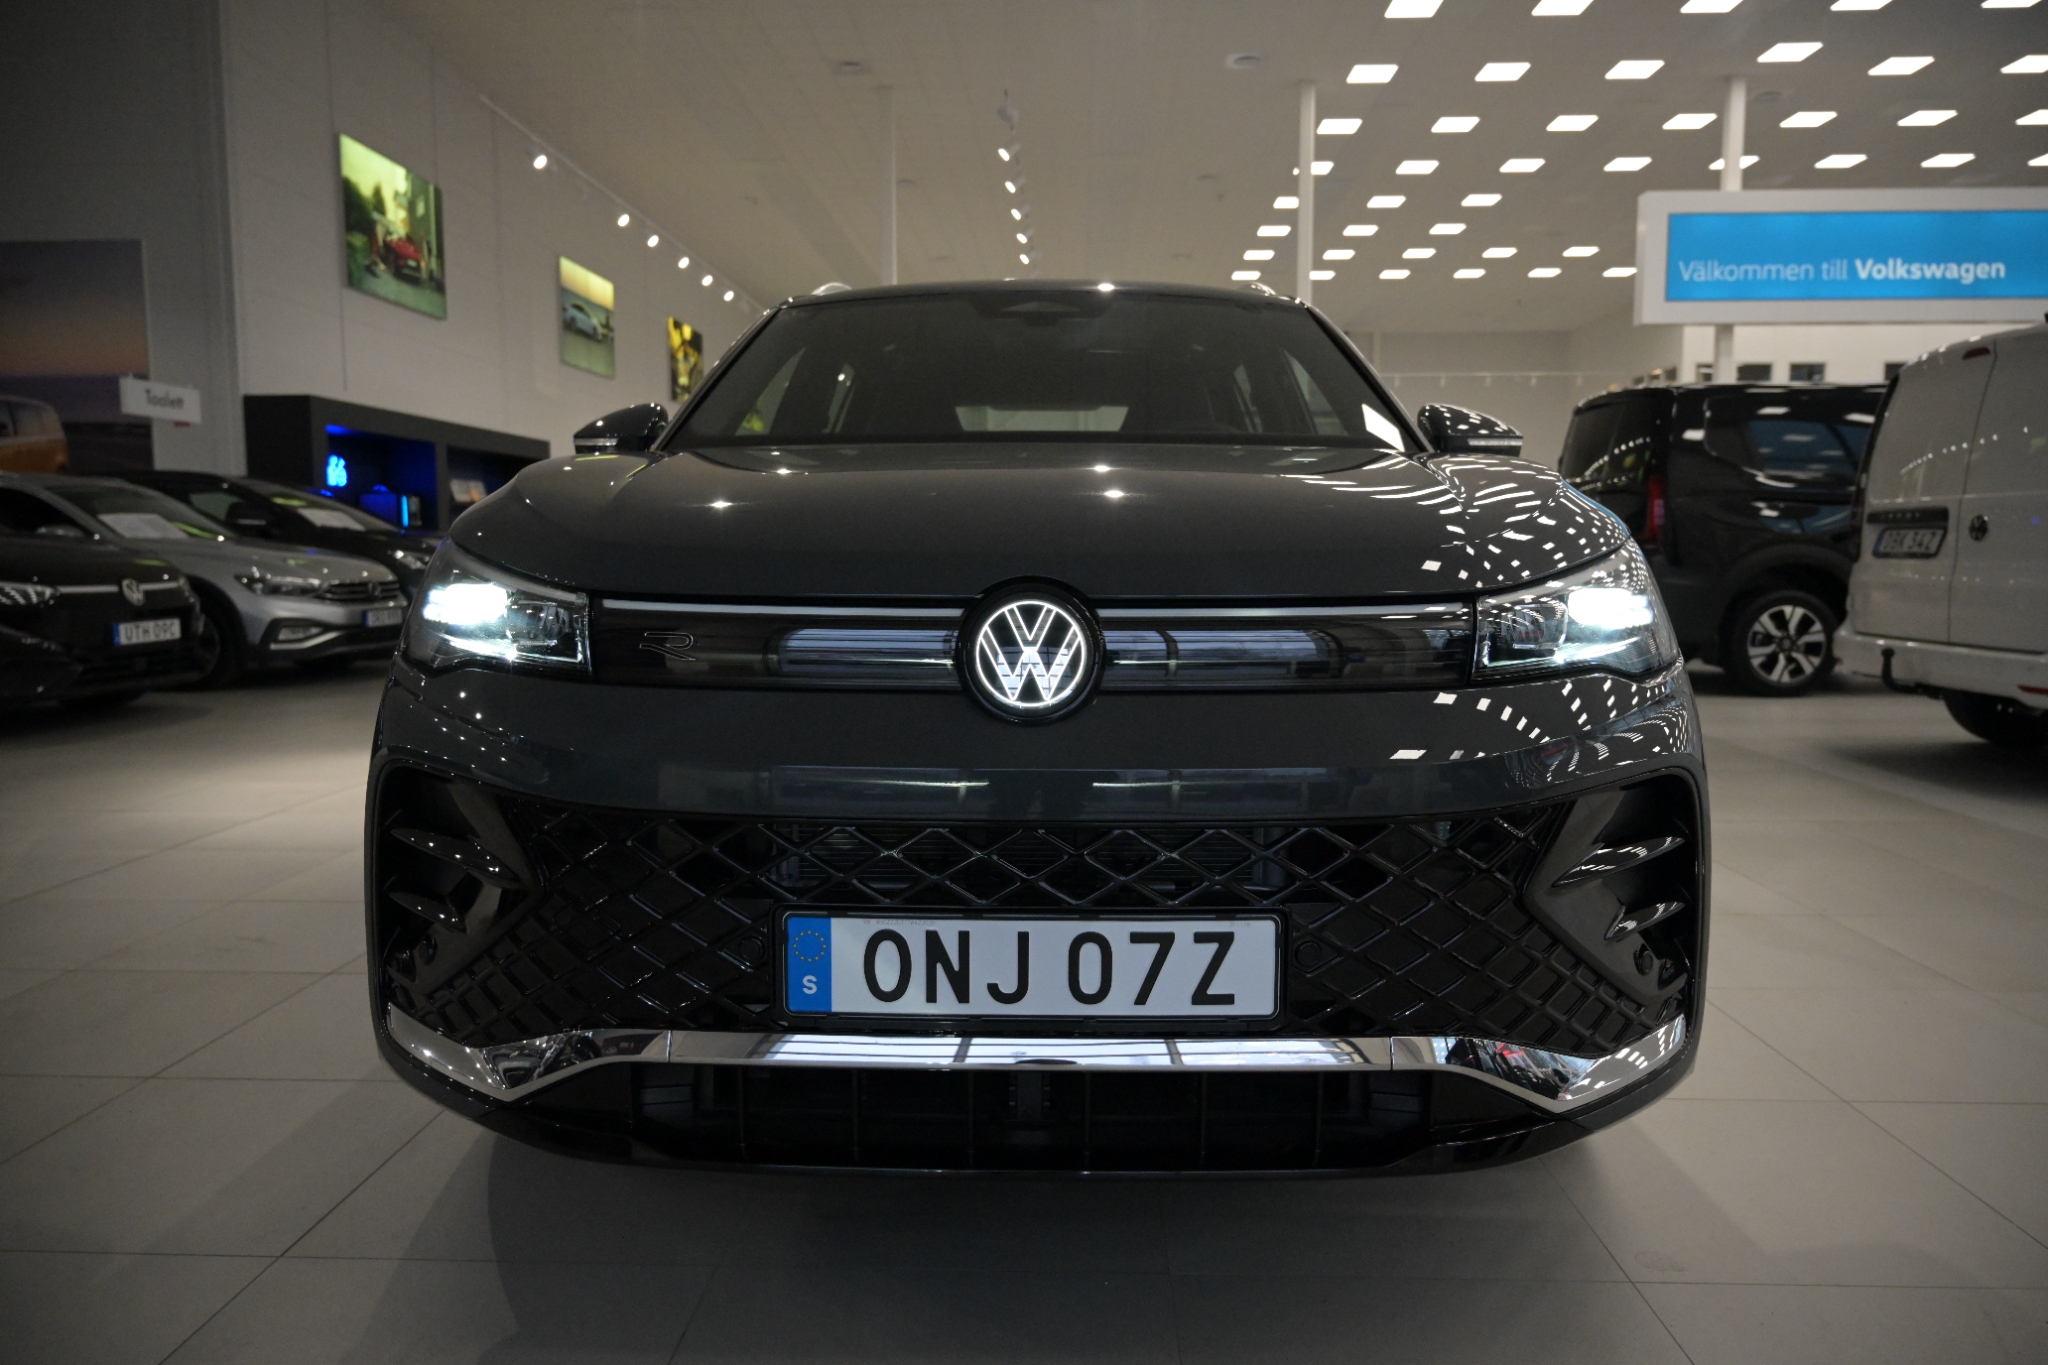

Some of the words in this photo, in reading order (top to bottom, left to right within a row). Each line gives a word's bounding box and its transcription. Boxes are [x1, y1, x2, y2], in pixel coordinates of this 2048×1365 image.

[1678, 259, 1814, 283] Välkommen
[1821, 257, 1849, 281] till
[1854, 257, 2007, 285] Volkswagen
[639, 631, 696, 661] R
[975, 600, 1087, 707] VW
[863, 929, 1030, 1005] ONJ
[1068, 931, 1236, 1006] 07Z
[802, 974, 818, 995] S
